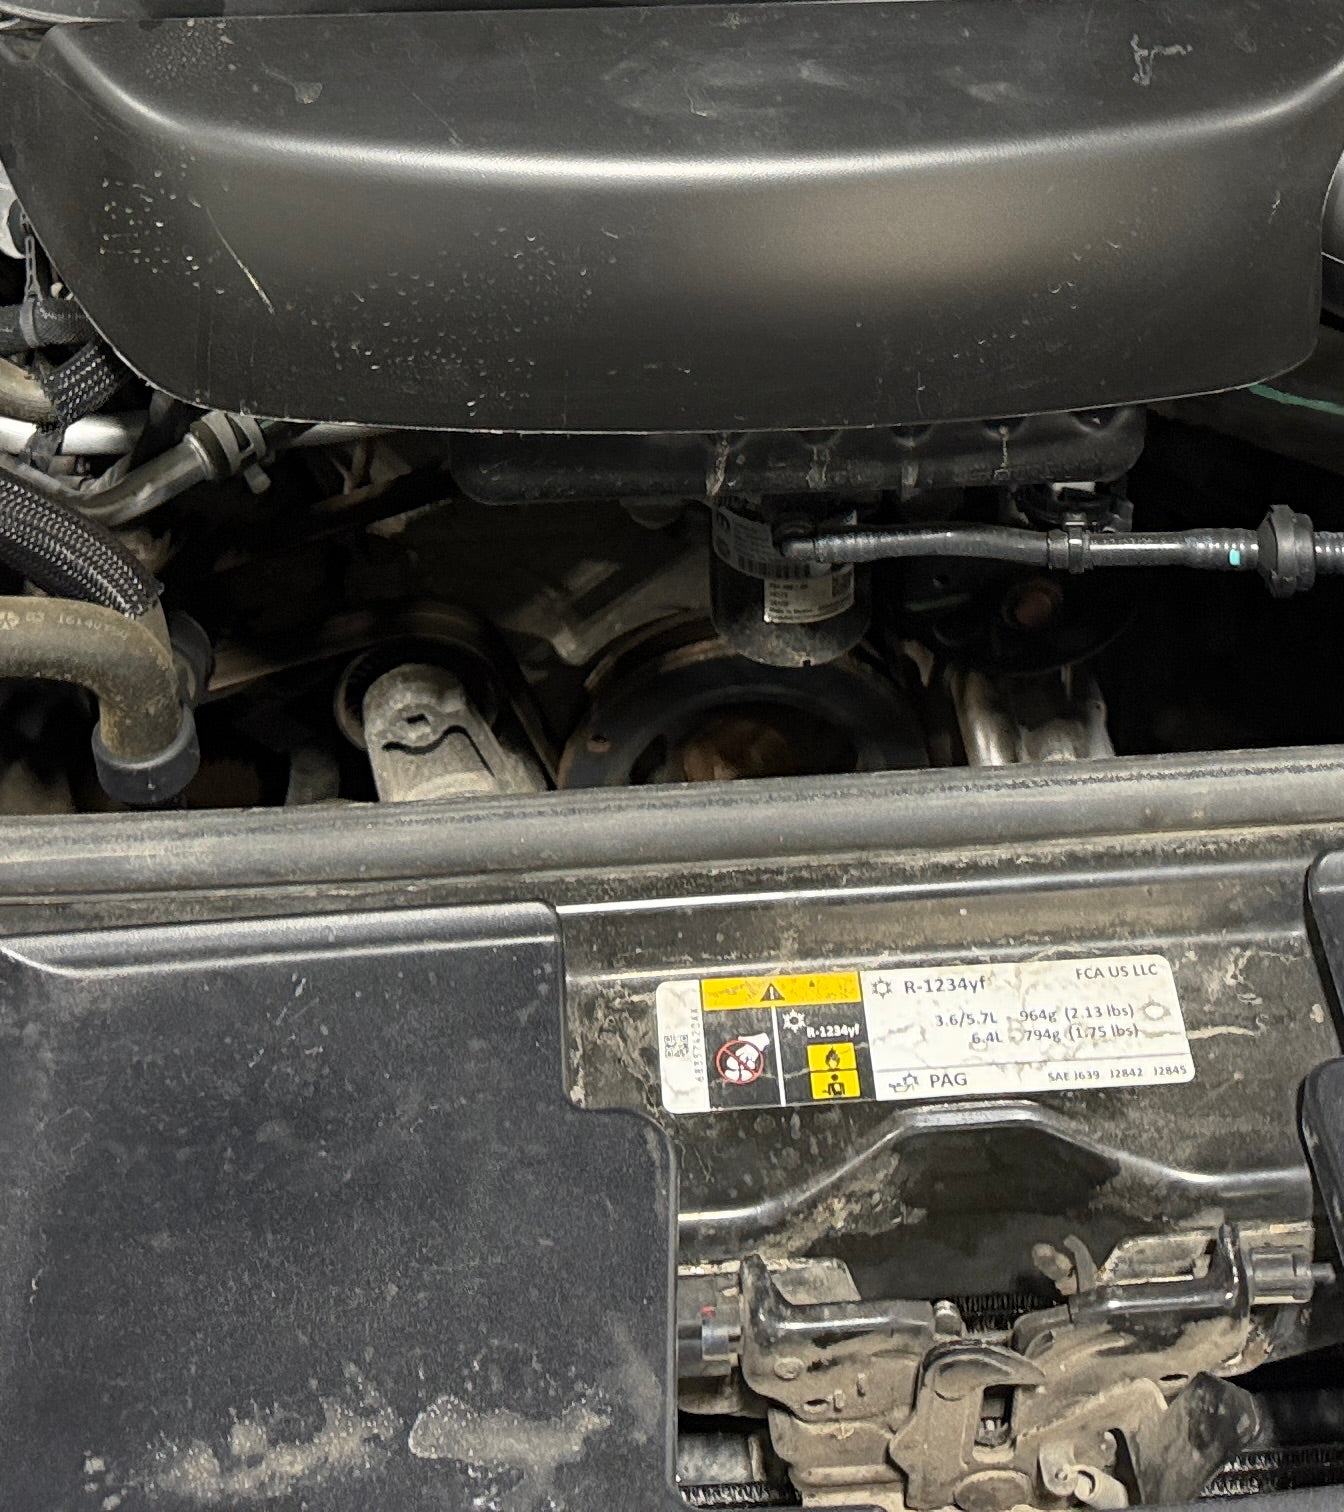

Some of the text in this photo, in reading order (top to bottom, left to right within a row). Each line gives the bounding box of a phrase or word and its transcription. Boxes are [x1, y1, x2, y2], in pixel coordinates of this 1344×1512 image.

[1074, 962, 1159, 981] FCA US LLC
[904, 974, 987, 995] R-1234yf
[934, 1003, 1135, 1028] 3.6/5.7L 964g (2.13 lbs)
[970, 1022, 1140, 1045] 6.4L 794g (1.75 lbs)
[928, 1071, 969, 1089] PAG
[1047, 1071, 1070, 1083] SAE
